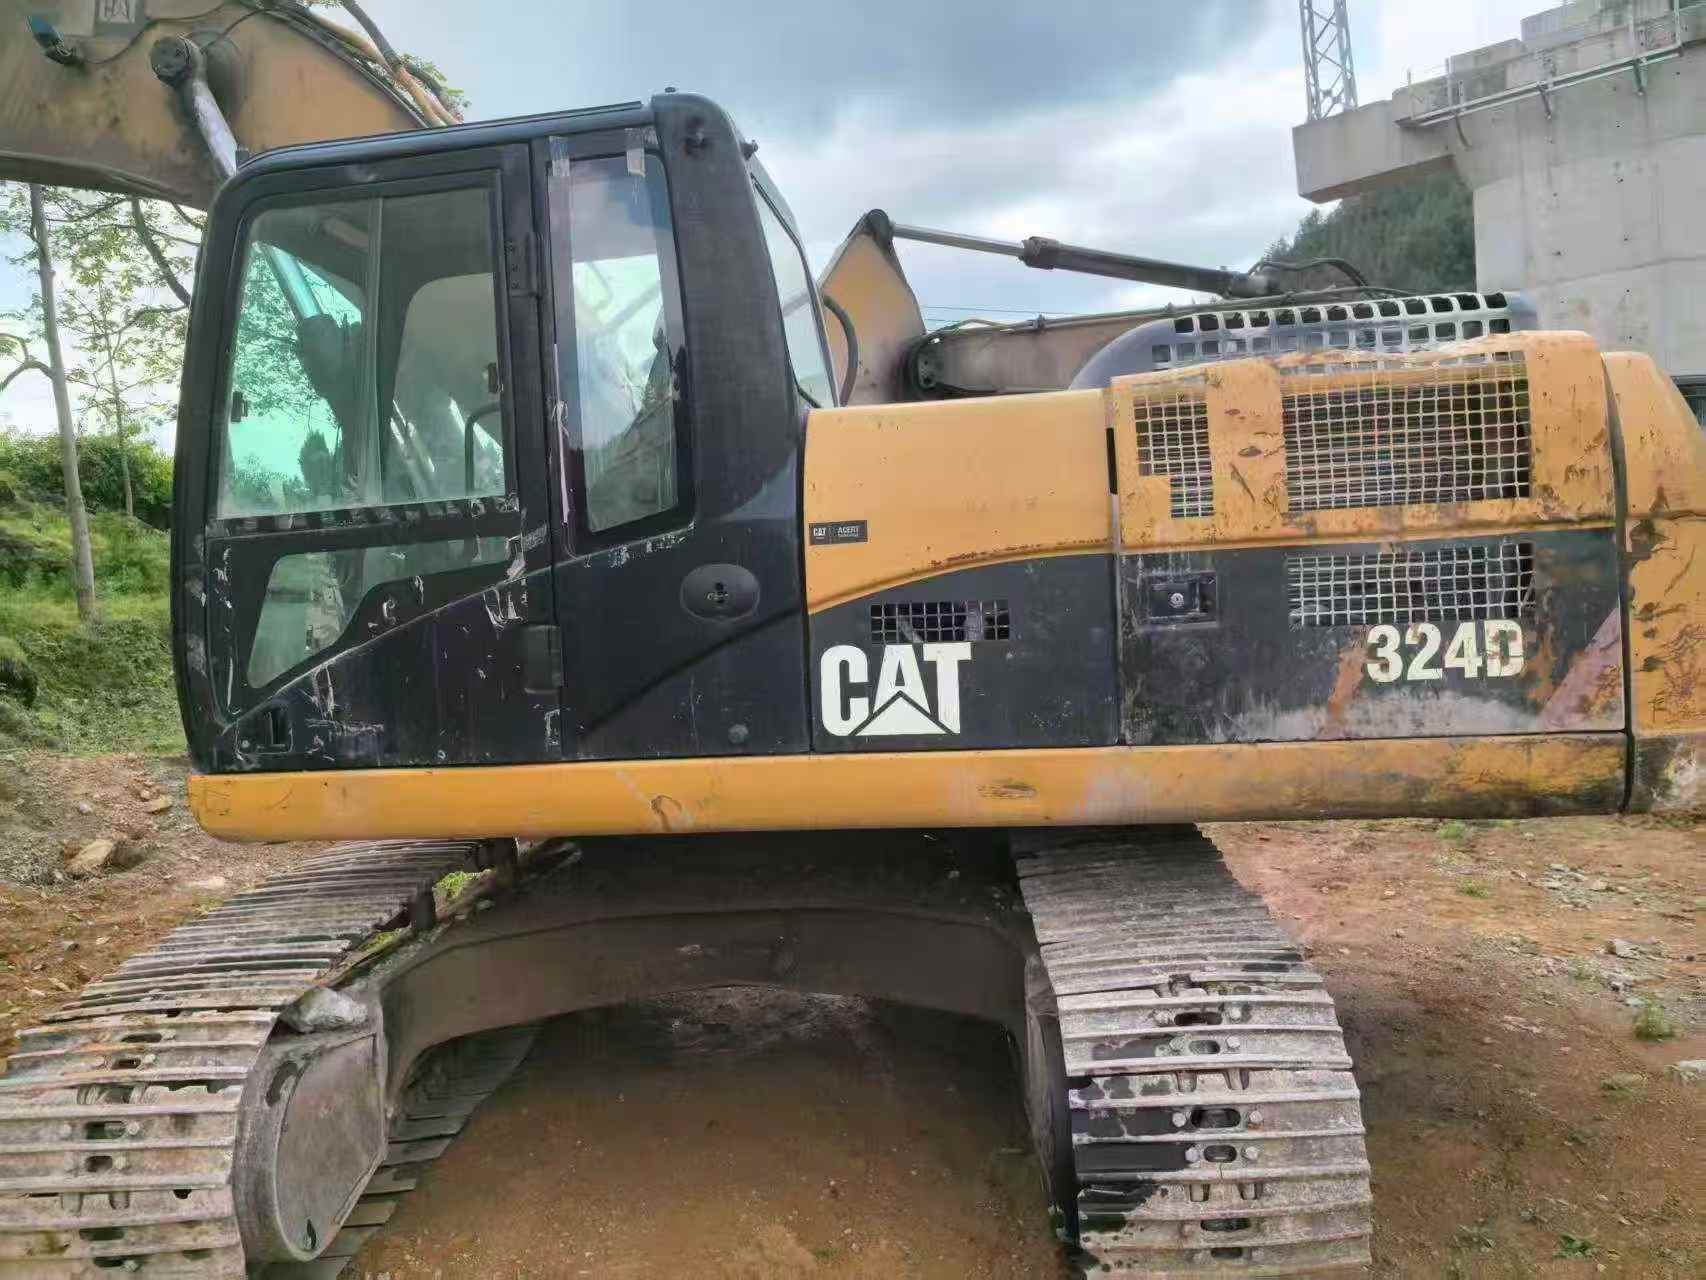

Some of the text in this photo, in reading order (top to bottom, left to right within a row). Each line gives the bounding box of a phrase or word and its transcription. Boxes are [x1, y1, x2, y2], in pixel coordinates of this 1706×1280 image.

[813, 527, 827, 537] CAT
[1366, 619, 1524, 683] 324D
[820, 642, 972, 737] CAT
